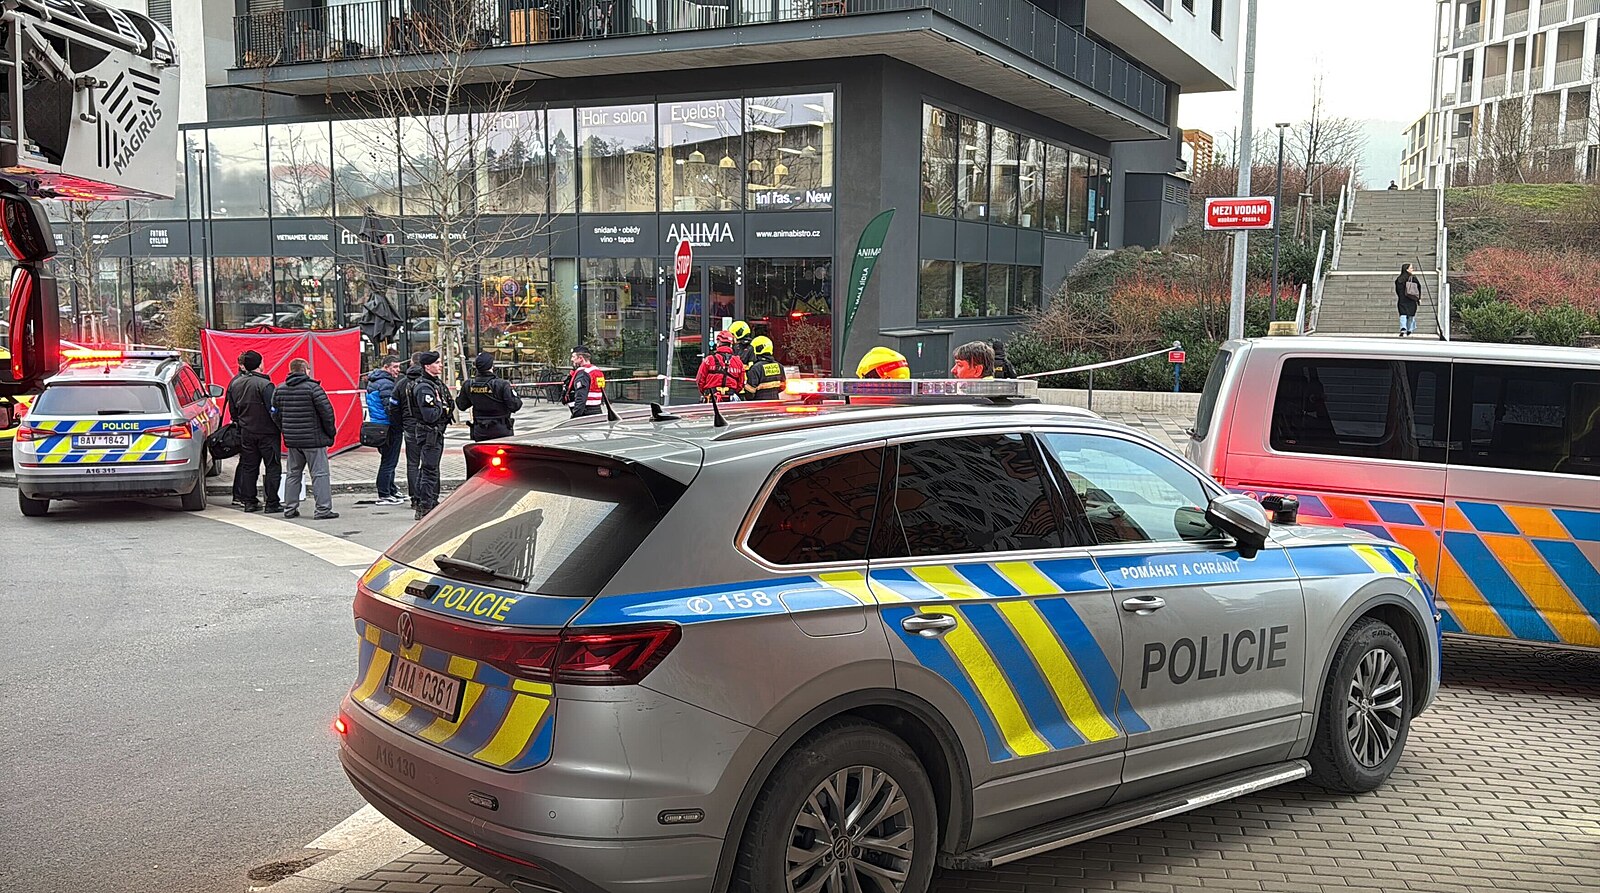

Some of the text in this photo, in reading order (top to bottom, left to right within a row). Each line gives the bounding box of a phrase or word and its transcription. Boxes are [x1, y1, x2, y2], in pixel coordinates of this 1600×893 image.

[581, 109, 648, 126] Hair salon
[671, 102, 725, 122] Eyelash
[113, 103, 162, 176] MAGIRUS
[805, 190, 832, 203] New
[1212, 205, 1267, 216] MEZI VODAMI
[594, 225, 641, 235] snídaně obědy
[666, 222, 735, 243] ANIMA
[756, 229, 821, 238] www.animabistro.cz
[618, 236, 635, 244] tapas
[677, 255, 690, 275] STOP
[102, 422, 140, 430] POLICIE
[80, 435, 125, 445] 8AV 1842
[1120, 558, 1241, 580] POMÁHAT A CHRÁNIT
[431, 584, 518, 622] POLICIE
[718, 591, 773, 610] 158
[1140, 625, 1289, 689] POLICIE
[398, 661, 417, 694] 1AA
[421, 675, 454, 710] C361
[376, 745, 394, 769] A16
